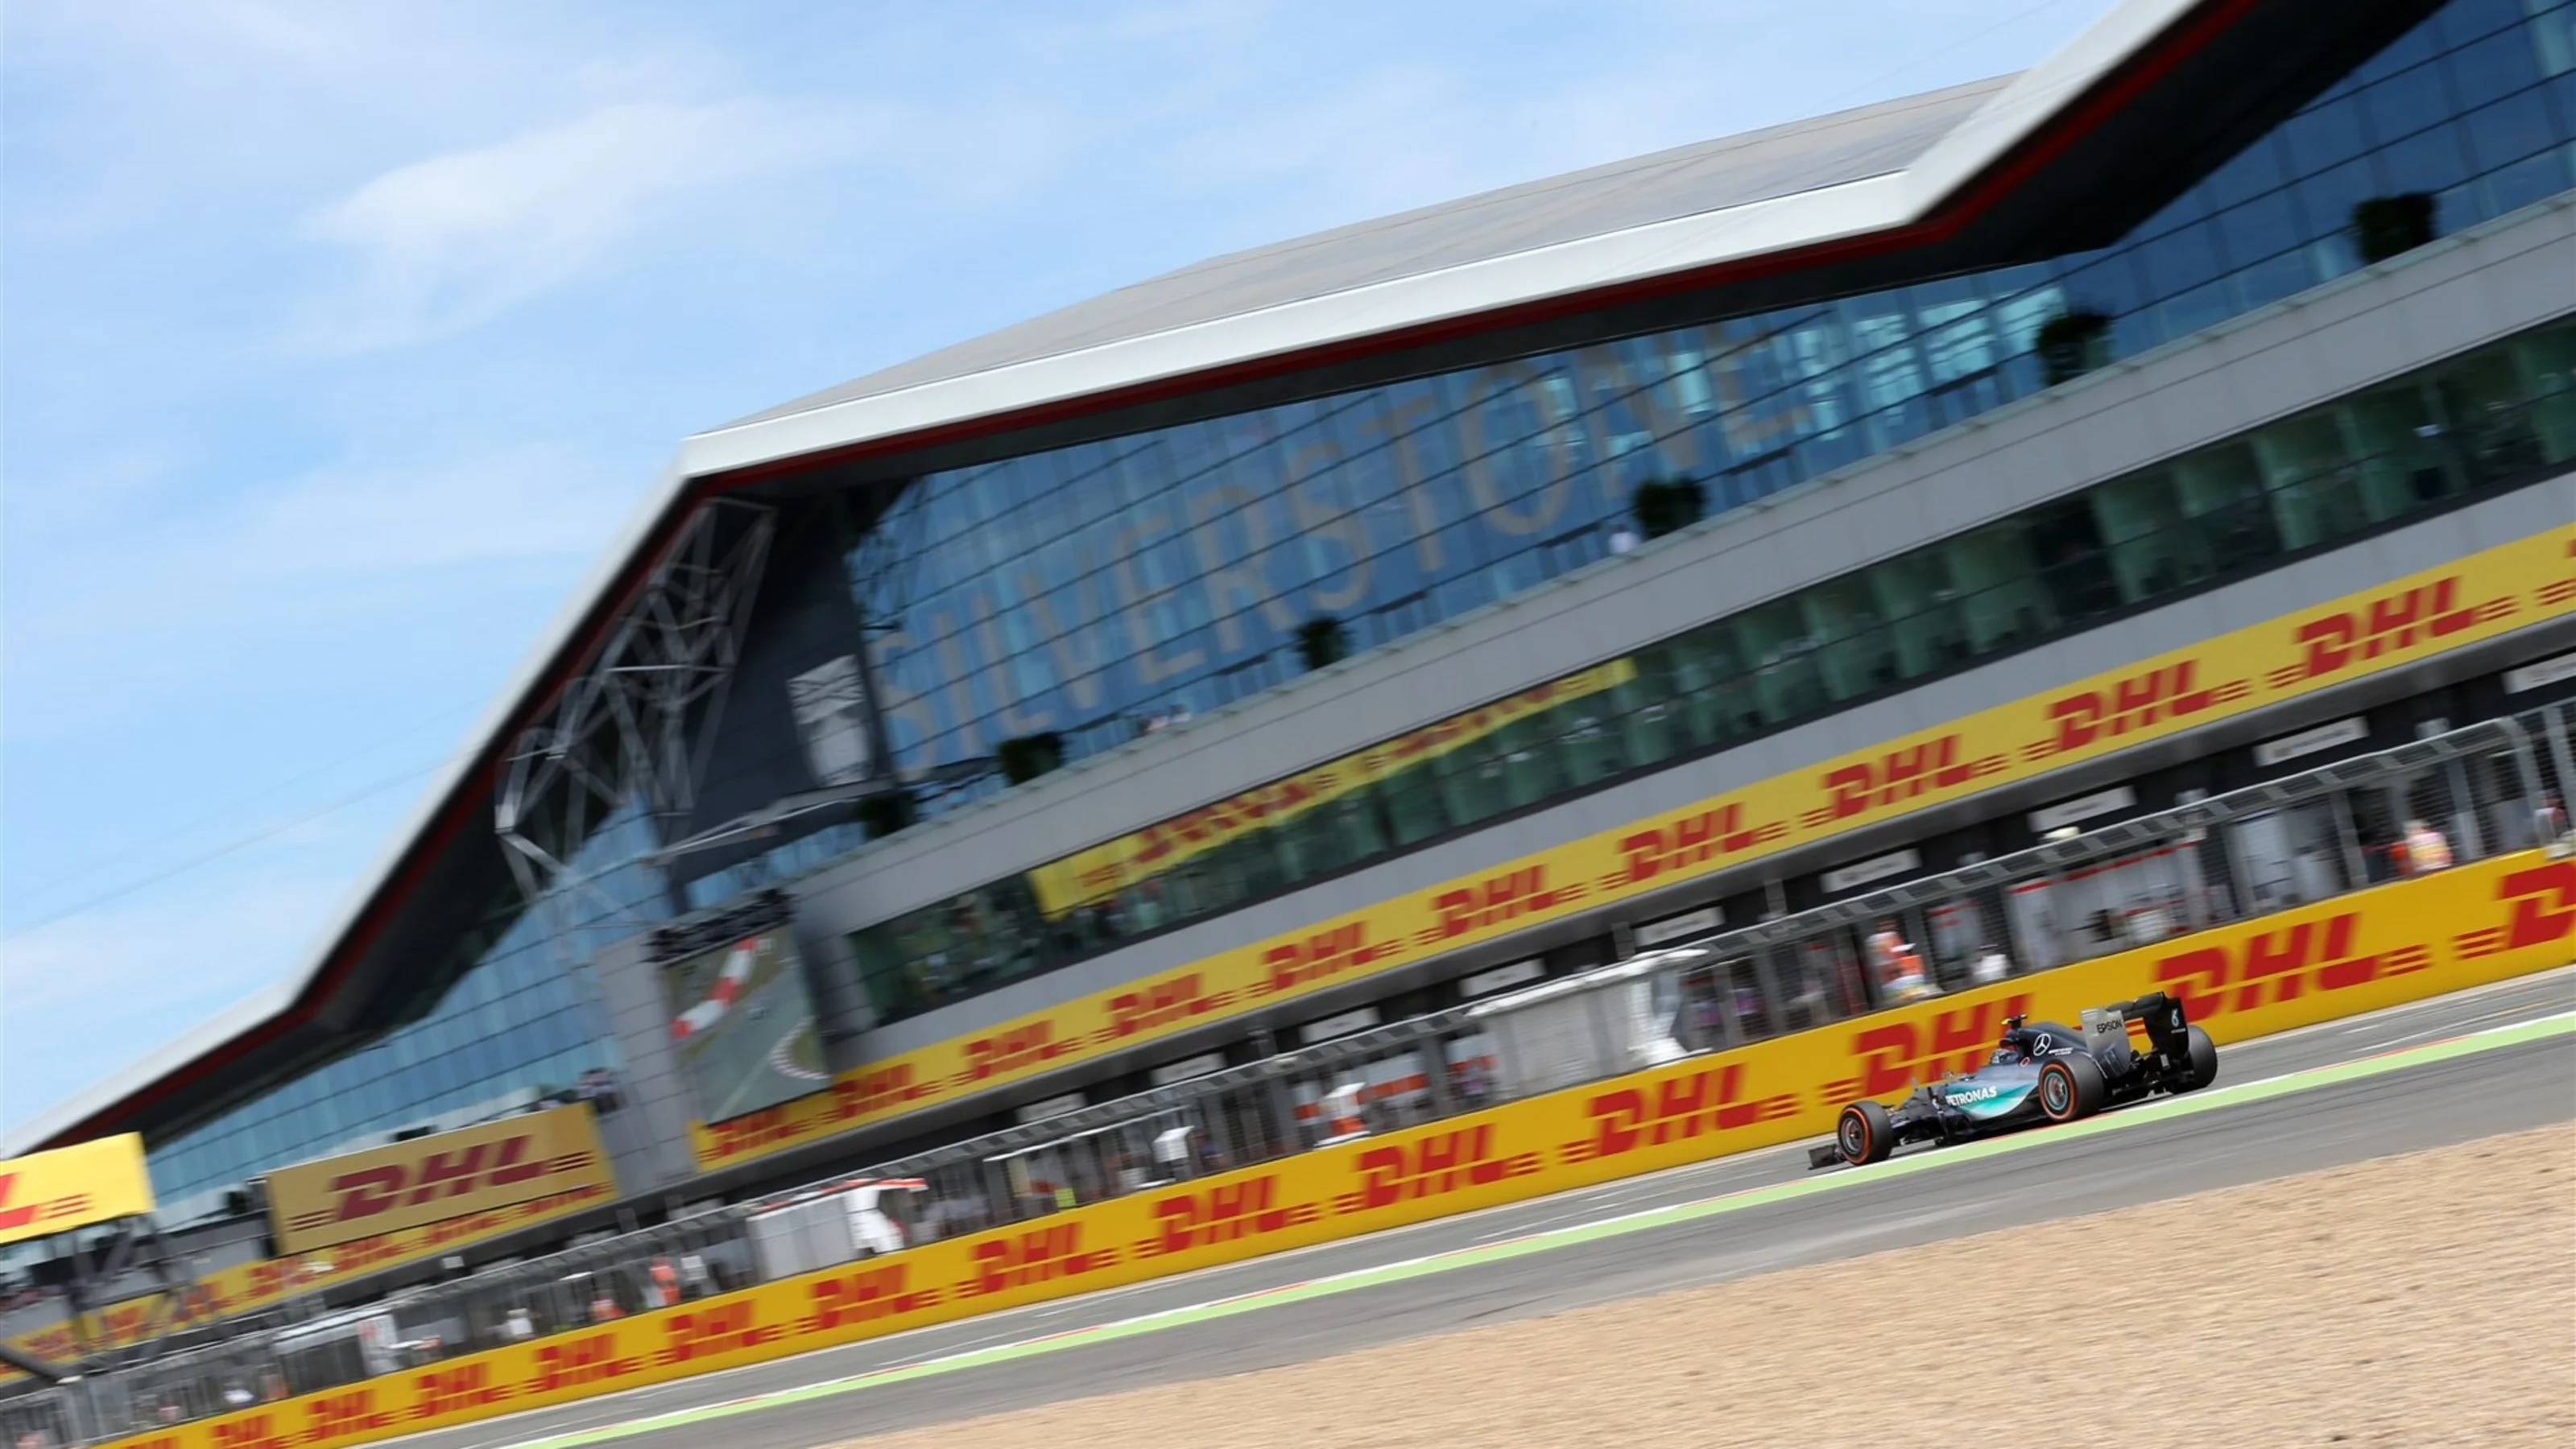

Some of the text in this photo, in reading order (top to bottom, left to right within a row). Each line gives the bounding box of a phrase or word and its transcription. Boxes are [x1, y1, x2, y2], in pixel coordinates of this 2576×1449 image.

[2295, 576, 2479, 677] DHL
[2046, 659, 2213, 751] DHL
[1821, 734, 1973, 818] DHL
[1619, 803, 1756, 881] DHL
[1432, 865, 1557, 938] DHL
[1263, 921, 1375, 990] DHL
[2156, 911, 2384, 1021] DHL
[1107, 972, 1208, 1038] DHL
[2096, 1018, 2123, 1034] EPSON
[965, 1020, 1061, 1080] DHL
[1586, 1063, 1764, 1157] DHL
[1945, 1086, 1998, 1106] PETRONAS
[329, 1133, 548, 1222] DHL
[1356, 1124, 1509, 1208] DHL
[1152, 1174, 1290, 1253] DHL
[972, 1221, 1091, 1293] DHL
[667, 1299, 759, 1362] DHL
[808, 1263, 926, 1328] DHL
